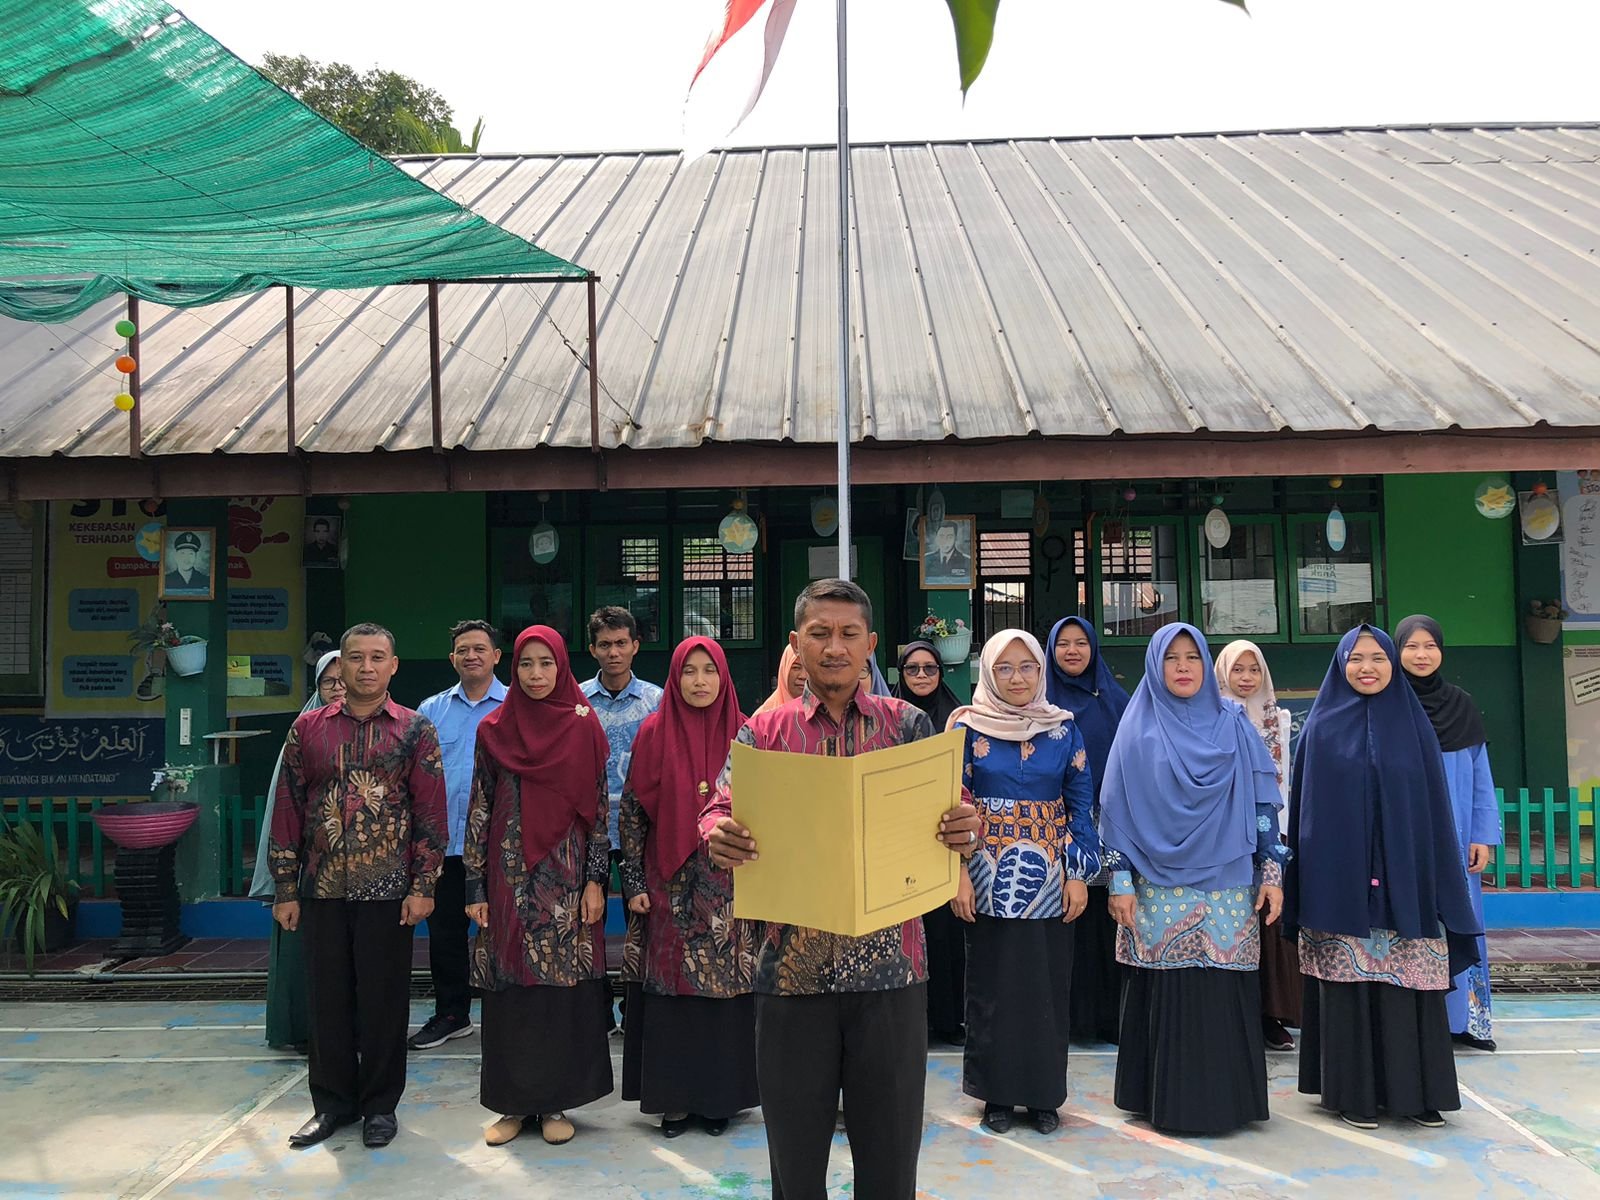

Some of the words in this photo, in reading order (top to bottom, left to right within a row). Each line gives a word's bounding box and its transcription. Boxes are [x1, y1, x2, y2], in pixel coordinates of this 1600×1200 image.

[69, 522, 136, 532] KEKERASAN
[74, 534, 135, 544] TERHADAP
[114, 562, 150, 572] Dampak
[228, 562, 244, 570] nak
[0, 775, 39, 785] IDATANGI
